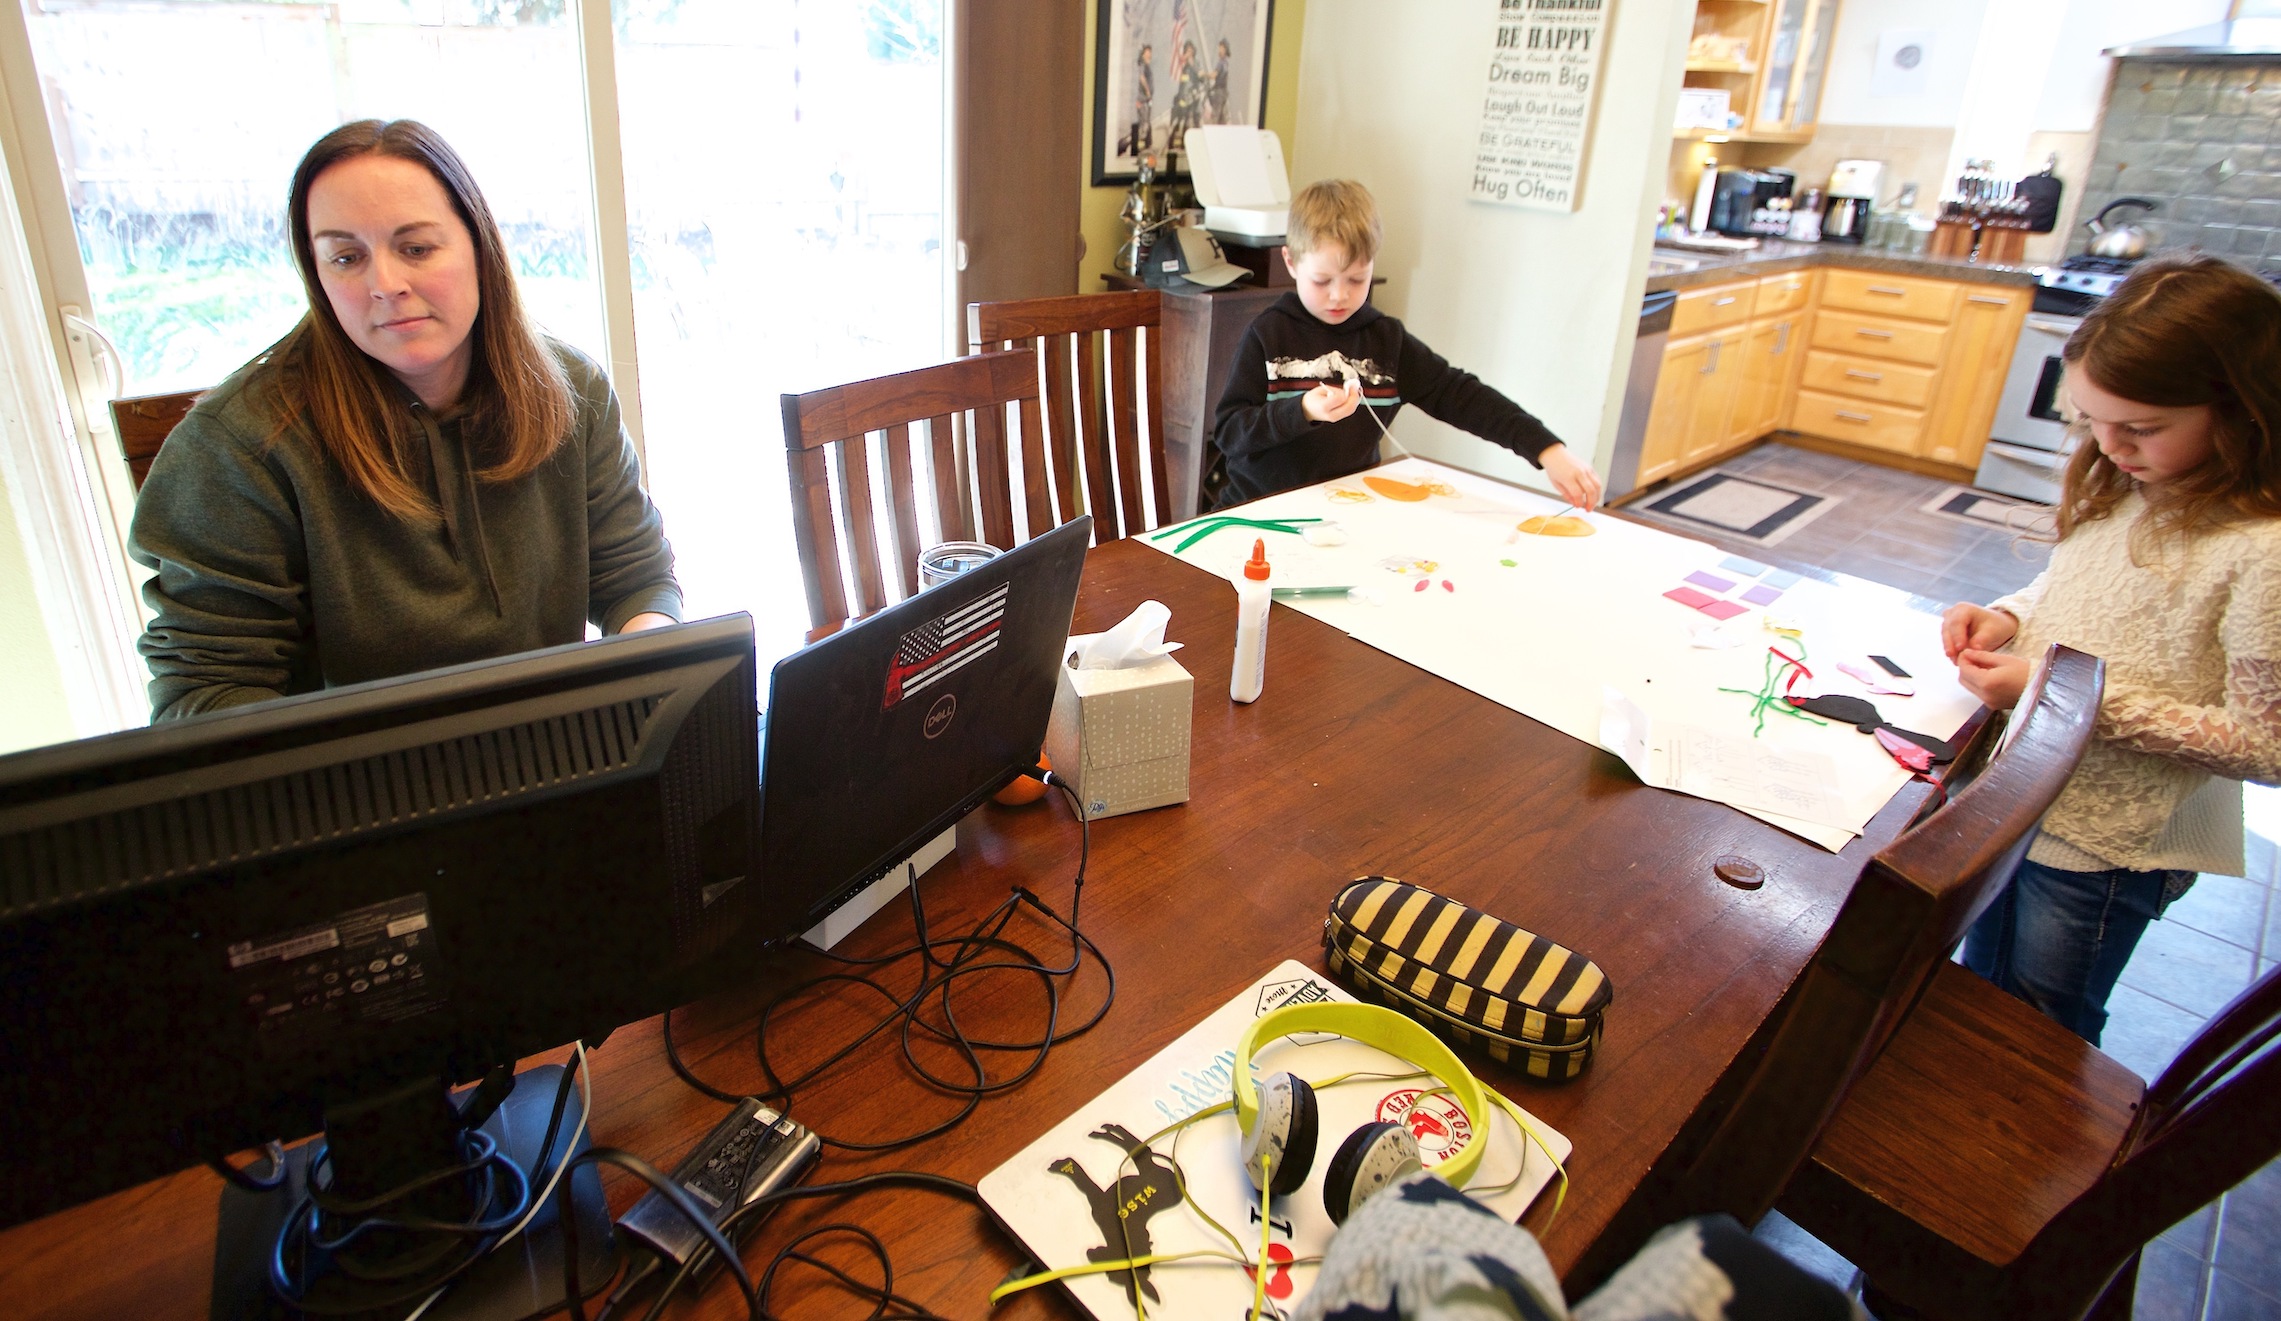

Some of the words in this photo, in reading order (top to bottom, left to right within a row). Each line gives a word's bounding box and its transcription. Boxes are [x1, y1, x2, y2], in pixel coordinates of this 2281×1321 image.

[1496, 26, 1522, 48] BE
[1527, 26, 1597, 50] HAPPY
[1488, 62, 1551, 84] Dream
[1558, 66, 1590, 93] Big
[1484, 98, 1522, 115] Laugh
[1525, 100, 1548, 115] Out
[1551, 102, 1585, 118] Loud
[1479, 131, 1499, 146] BE
[1502, 133, 1576, 154] GRATEFUL
[1472, 173, 1509, 201] Hug
[1515, 178, 1569, 203] Often
[927, 705, 952, 727] DELL
[1386, 1093, 1415, 1114] RED
[1118, 1185, 1157, 1219] wise
